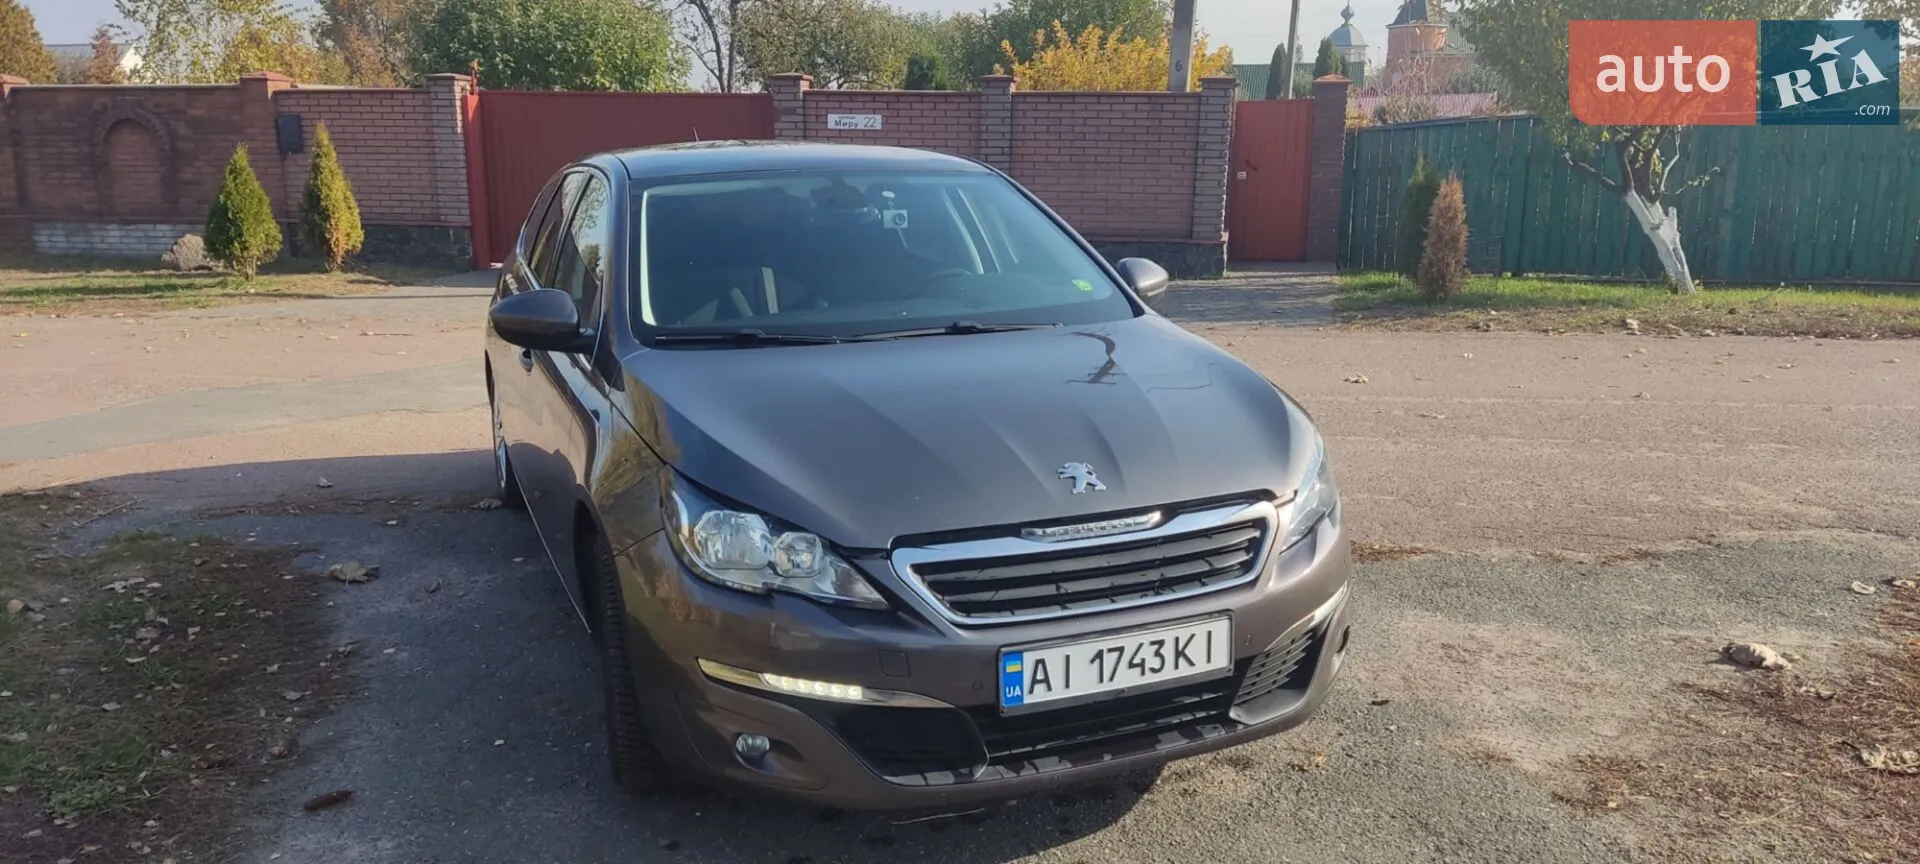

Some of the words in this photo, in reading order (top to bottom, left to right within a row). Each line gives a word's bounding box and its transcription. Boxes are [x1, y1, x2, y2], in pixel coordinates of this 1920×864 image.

[834, 119, 859, 129] Миру
[863, 116, 877, 128] 22
[1005, 685, 1022, 698] UA
